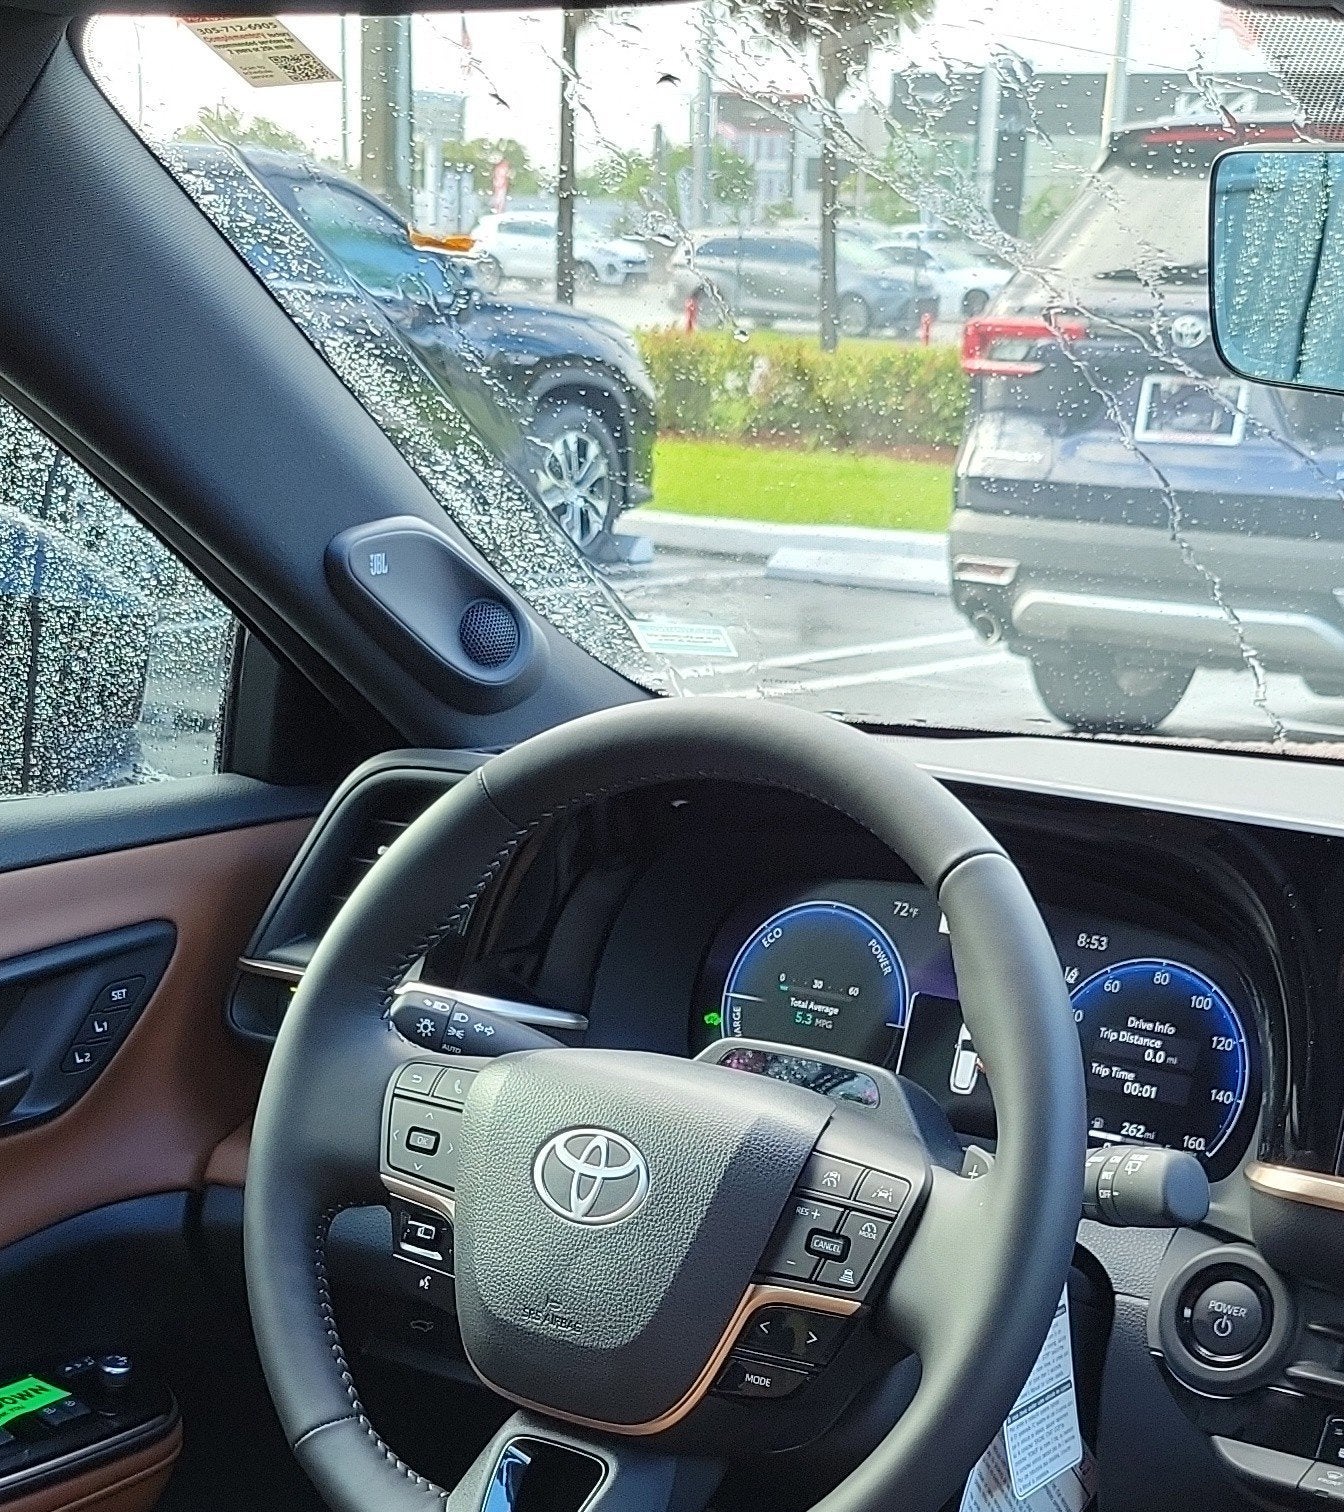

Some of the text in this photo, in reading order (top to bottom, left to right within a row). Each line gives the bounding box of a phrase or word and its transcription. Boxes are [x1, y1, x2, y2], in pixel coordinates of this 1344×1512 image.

[761, 927, 783, 948] ECO
[1077, 933, 1108, 950] 8:53
[867, 938, 893, 976] POWER
[779, 973, 786, 982] 0
[812, 979, 824, 989] 30
[1153, 971, 1170, 986] 80
[848, 986, 859, 996] 60
[1104, 979, 1121, 993] 60
[111, 988, 128, 1001] SET
[790, 997, 839, 1016] Total Average
[1190, 995, 1213, 1011] 100
[795, 1011, 833, 1030] 5.3 MPG
[1127, 1016, 1177, 1035] Drive Info
[1099, 1027, 1164, 1049] Trip Distance
[1211, 1036, 1234, 1051] 120
[441, 1044, 462, 1054] AUTO
[1144, 1049, 1166, 1064] 0.0
[1091, 1062, 1136, 1081] Trip Time
[1123, 1081, 1157, 1099] 00:01
[1210, 1088, 1234, 1104] 140
[1182, 1135, 1206, 1151] 160
[1098, 1189, 1112, 1199] OFF
[796, 1206, 810, 1217] RES
[858, 1230, 877, 1240] MODE
[813, 1239, 841, 1253] CANCEL
[1208, 1300, 1248, 1318] POWER
[745, 1373, 772, 1388] MODE
